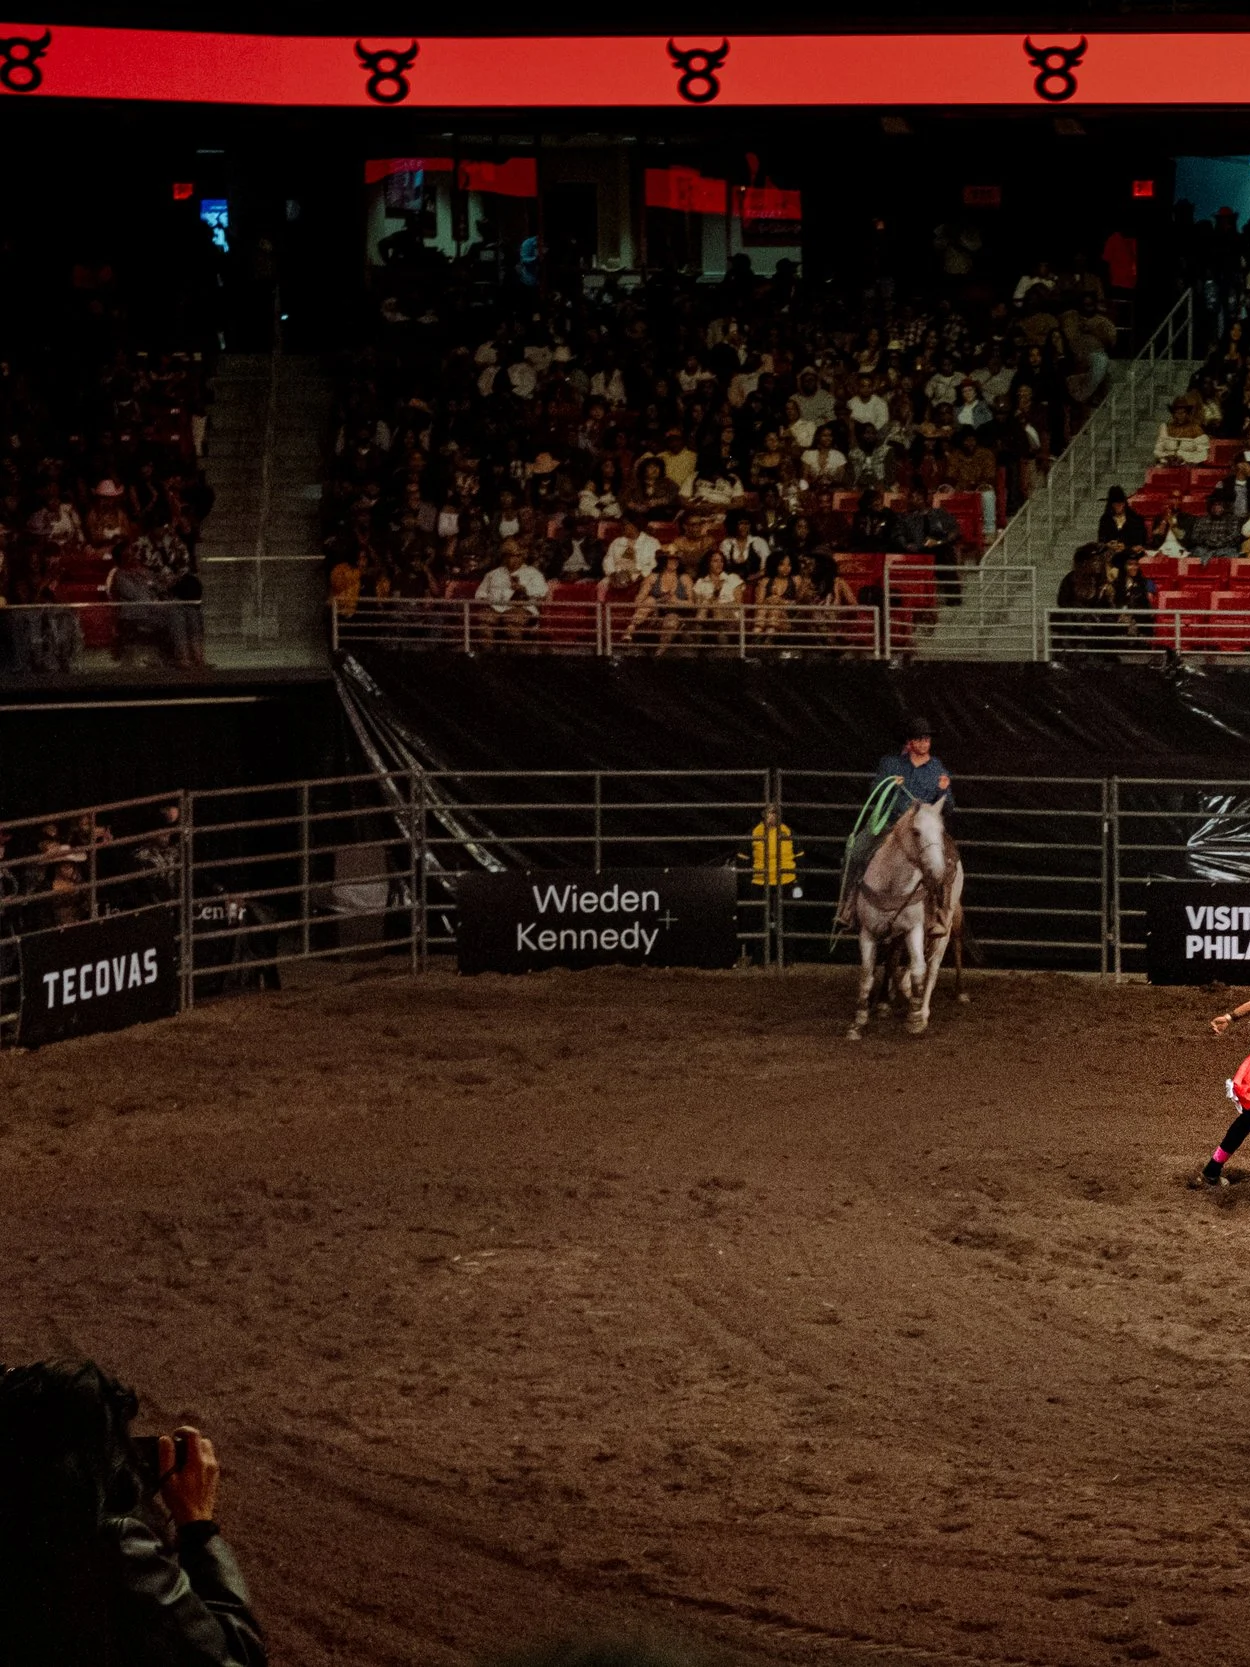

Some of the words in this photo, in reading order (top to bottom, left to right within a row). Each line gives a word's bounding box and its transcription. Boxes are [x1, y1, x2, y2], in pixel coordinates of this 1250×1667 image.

[532, 884, 660, 913] Wieden
[517, 921, 659, 955] Kennedy
[43, 947, 159, 1009] TECOVAS
